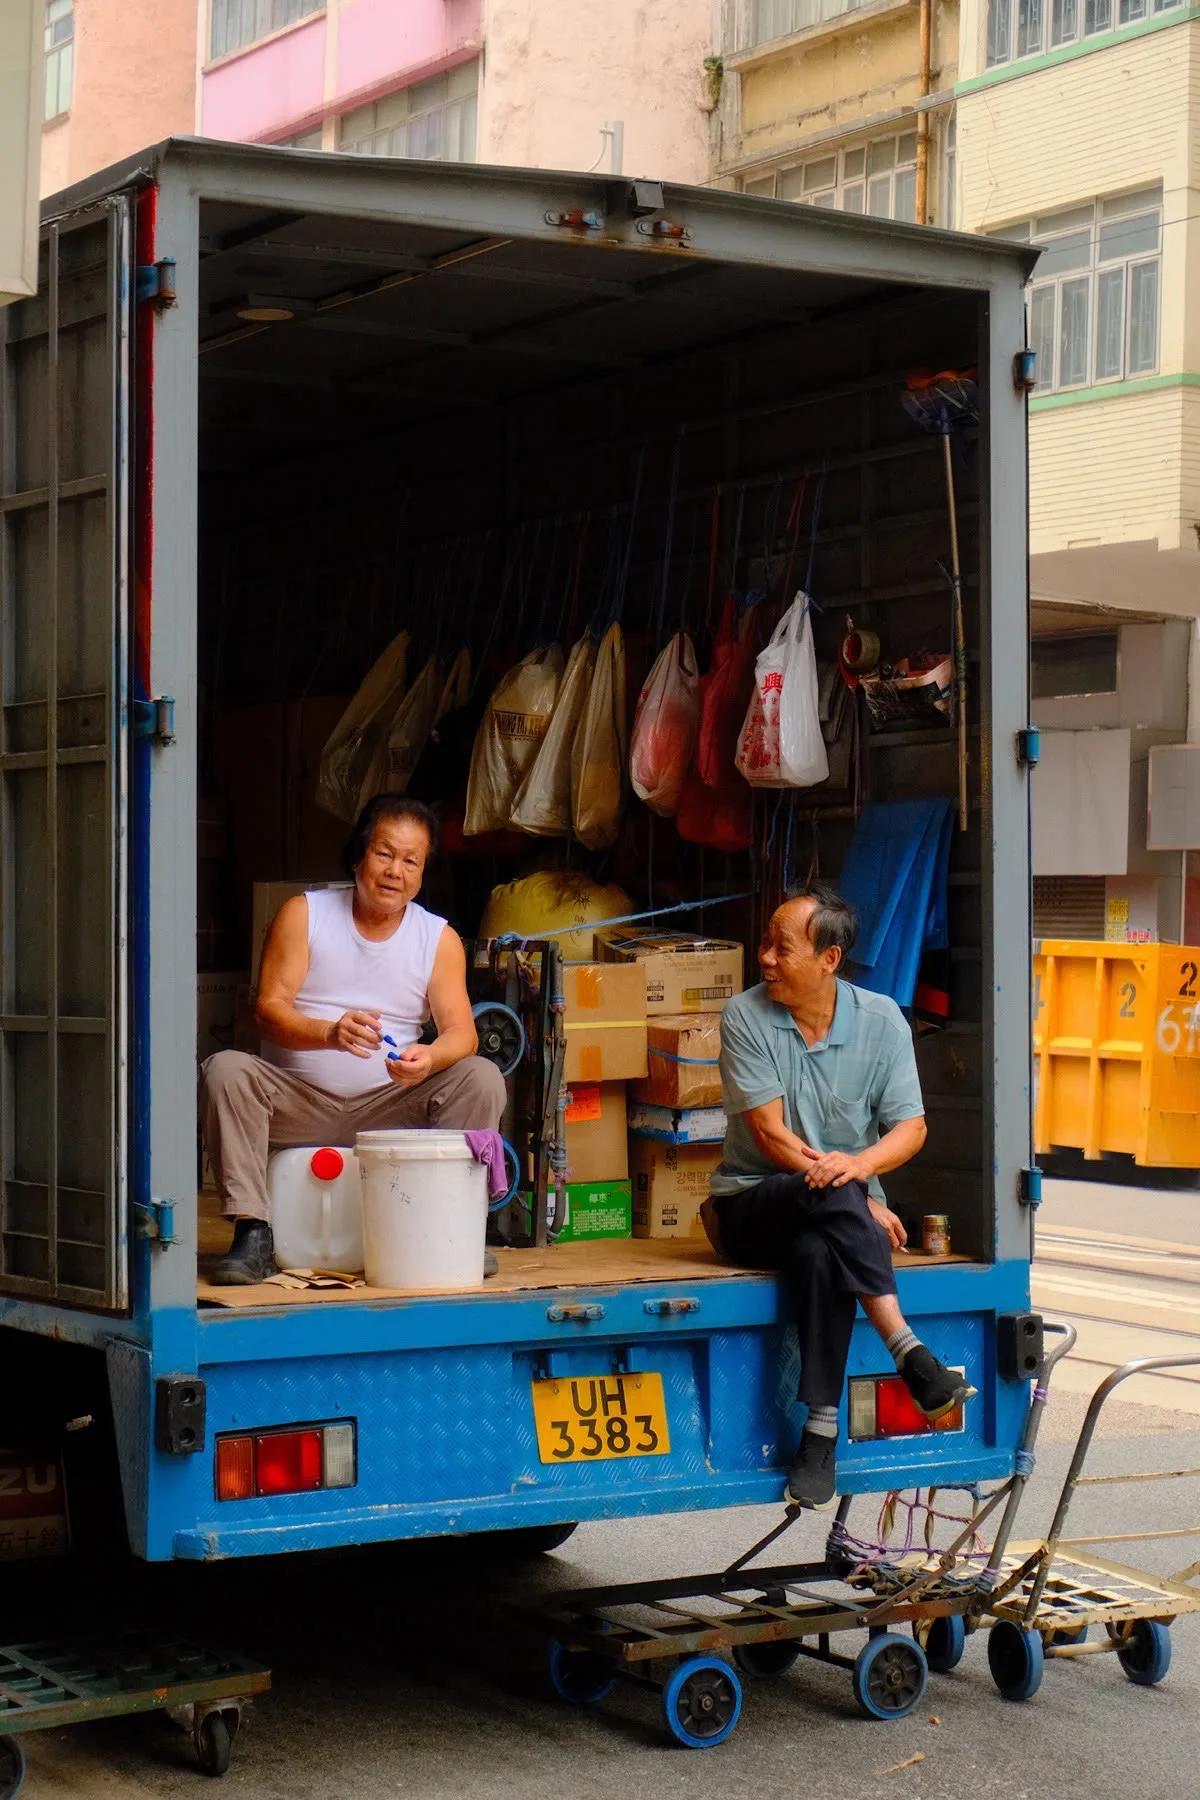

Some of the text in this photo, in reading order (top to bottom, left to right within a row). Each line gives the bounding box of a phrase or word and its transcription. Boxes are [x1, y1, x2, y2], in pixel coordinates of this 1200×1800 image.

[1178, 961, 1198, 997] 2
[1119, 983, 1137, 1018] 2
[571, 1378, 627, 1417] UH
[551, 1415, 658, 1459] 3383
